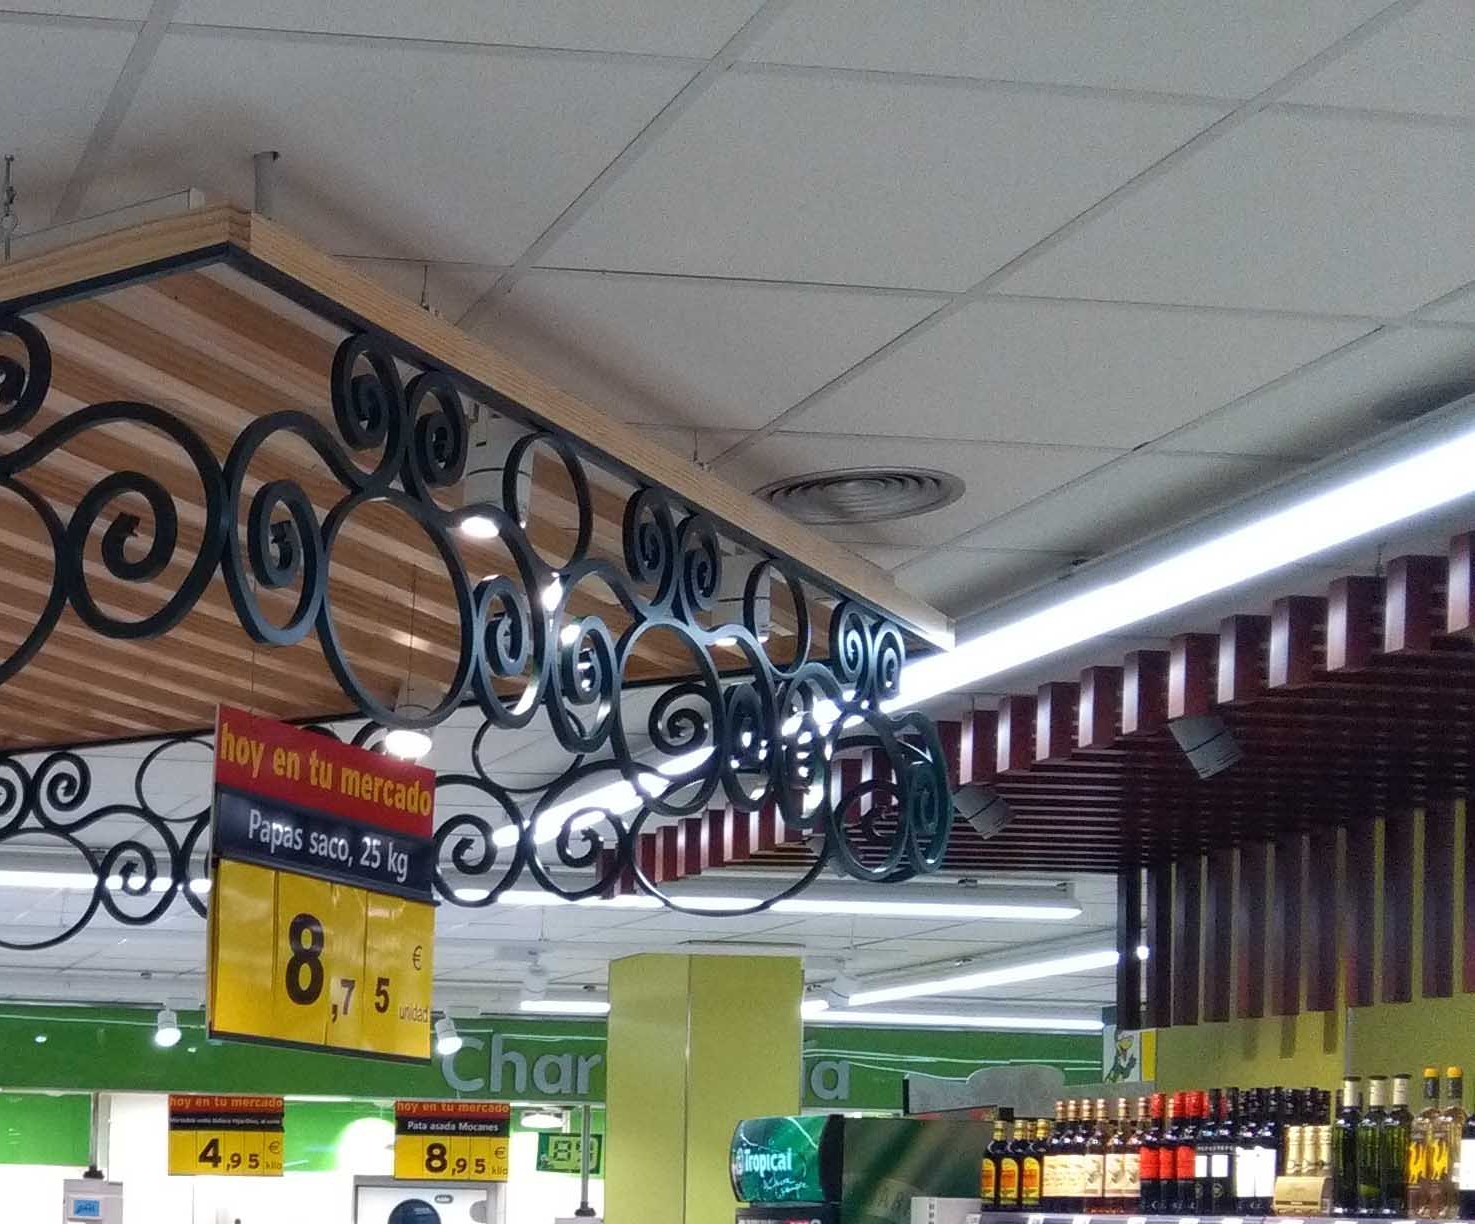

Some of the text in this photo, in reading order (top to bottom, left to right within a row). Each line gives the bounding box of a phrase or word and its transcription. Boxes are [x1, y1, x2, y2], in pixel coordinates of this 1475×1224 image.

[221, 723, 432, 817] hoy en tu mercado
[248, 808, 409, 883] Papas saco, 25 kg
[411, 944, 424, 971] €
[397, 1002, 430, 1023] unidad
[169, 1096, 283, 1109] hoy en tu mercado
[423, 1103, 437, 1112] en
[442, 1102, 454, 1112] tu
[458, 1102, 510, 1113] mercado
[407, 1120, 427, 1130] Pata
[429, 1121, 456, 1131] asada
[744, 1147, 793, 1178] Tropical
